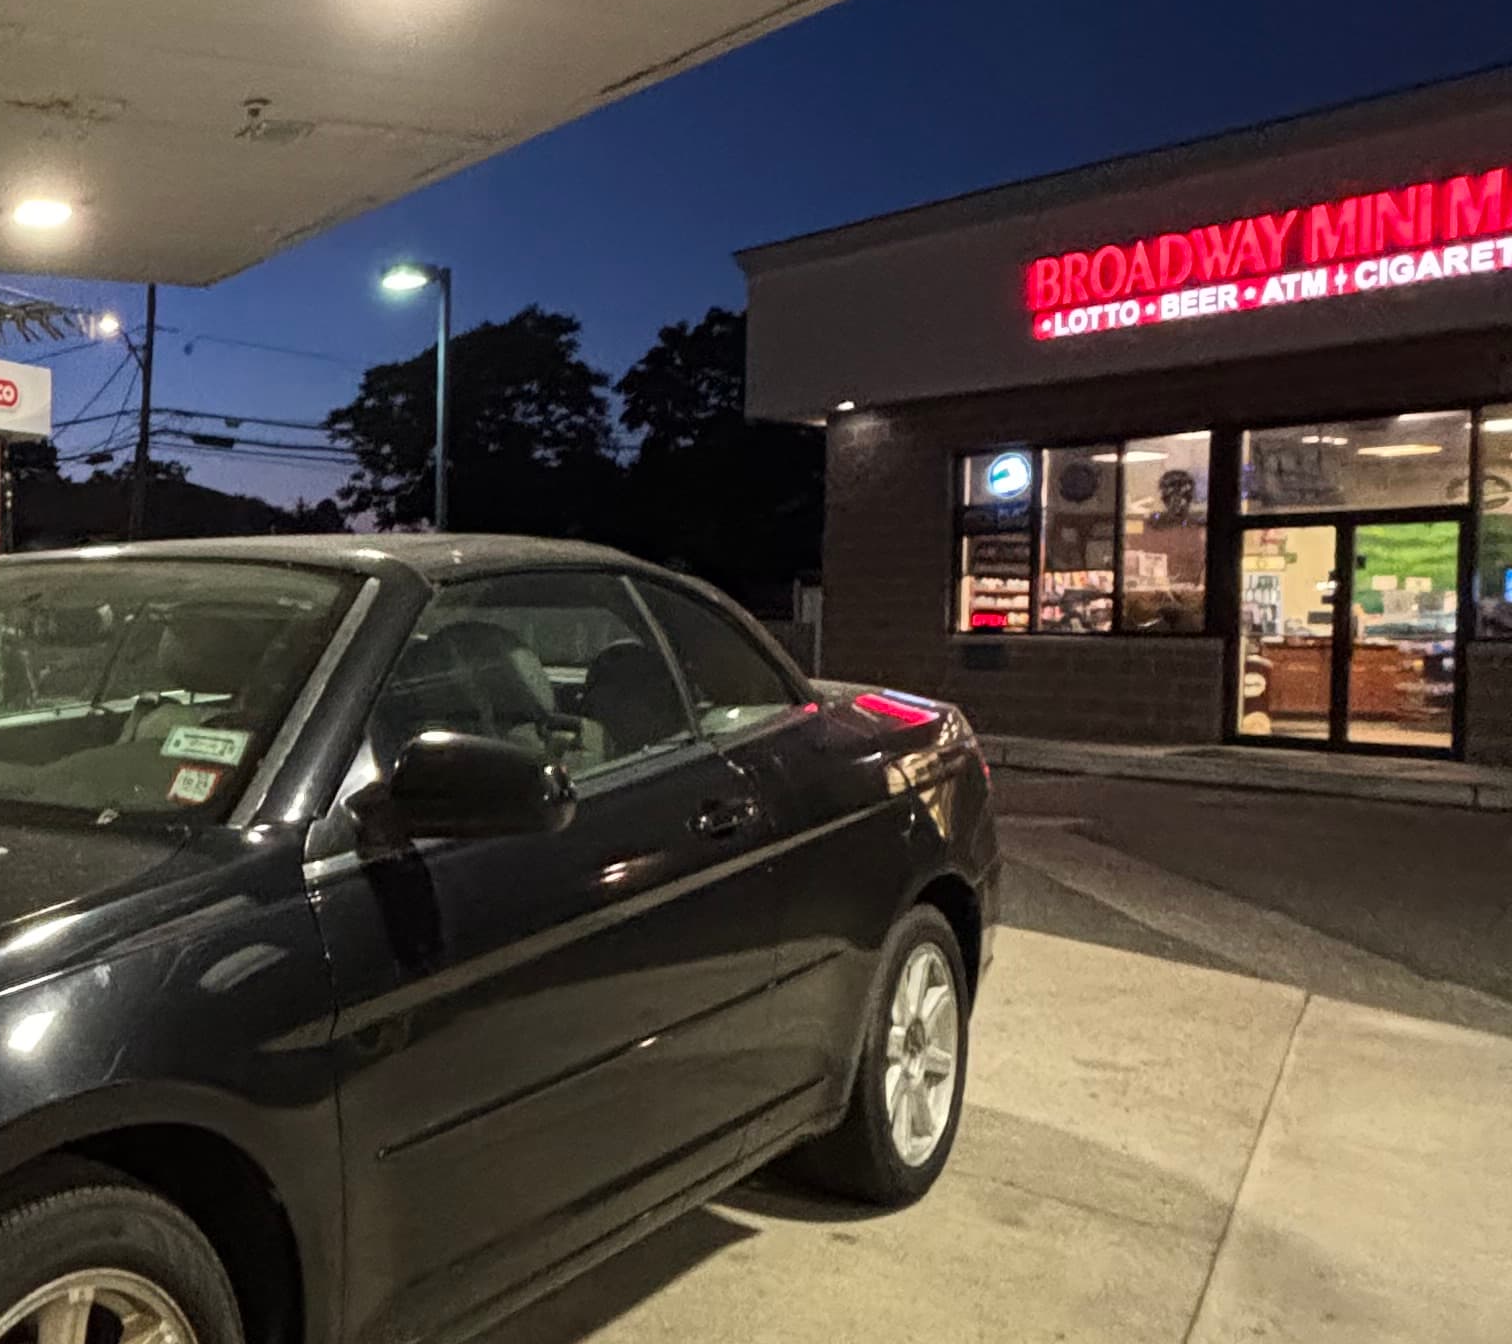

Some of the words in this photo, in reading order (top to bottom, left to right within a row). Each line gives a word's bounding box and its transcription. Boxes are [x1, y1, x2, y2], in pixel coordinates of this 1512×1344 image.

[1032, 209, 1299, 307] BROADWAY
[1306, 182, 1433, 263] MINI
[1445, 166, 1512, 240] M
[1260, 269, 1328, 305] ATM
